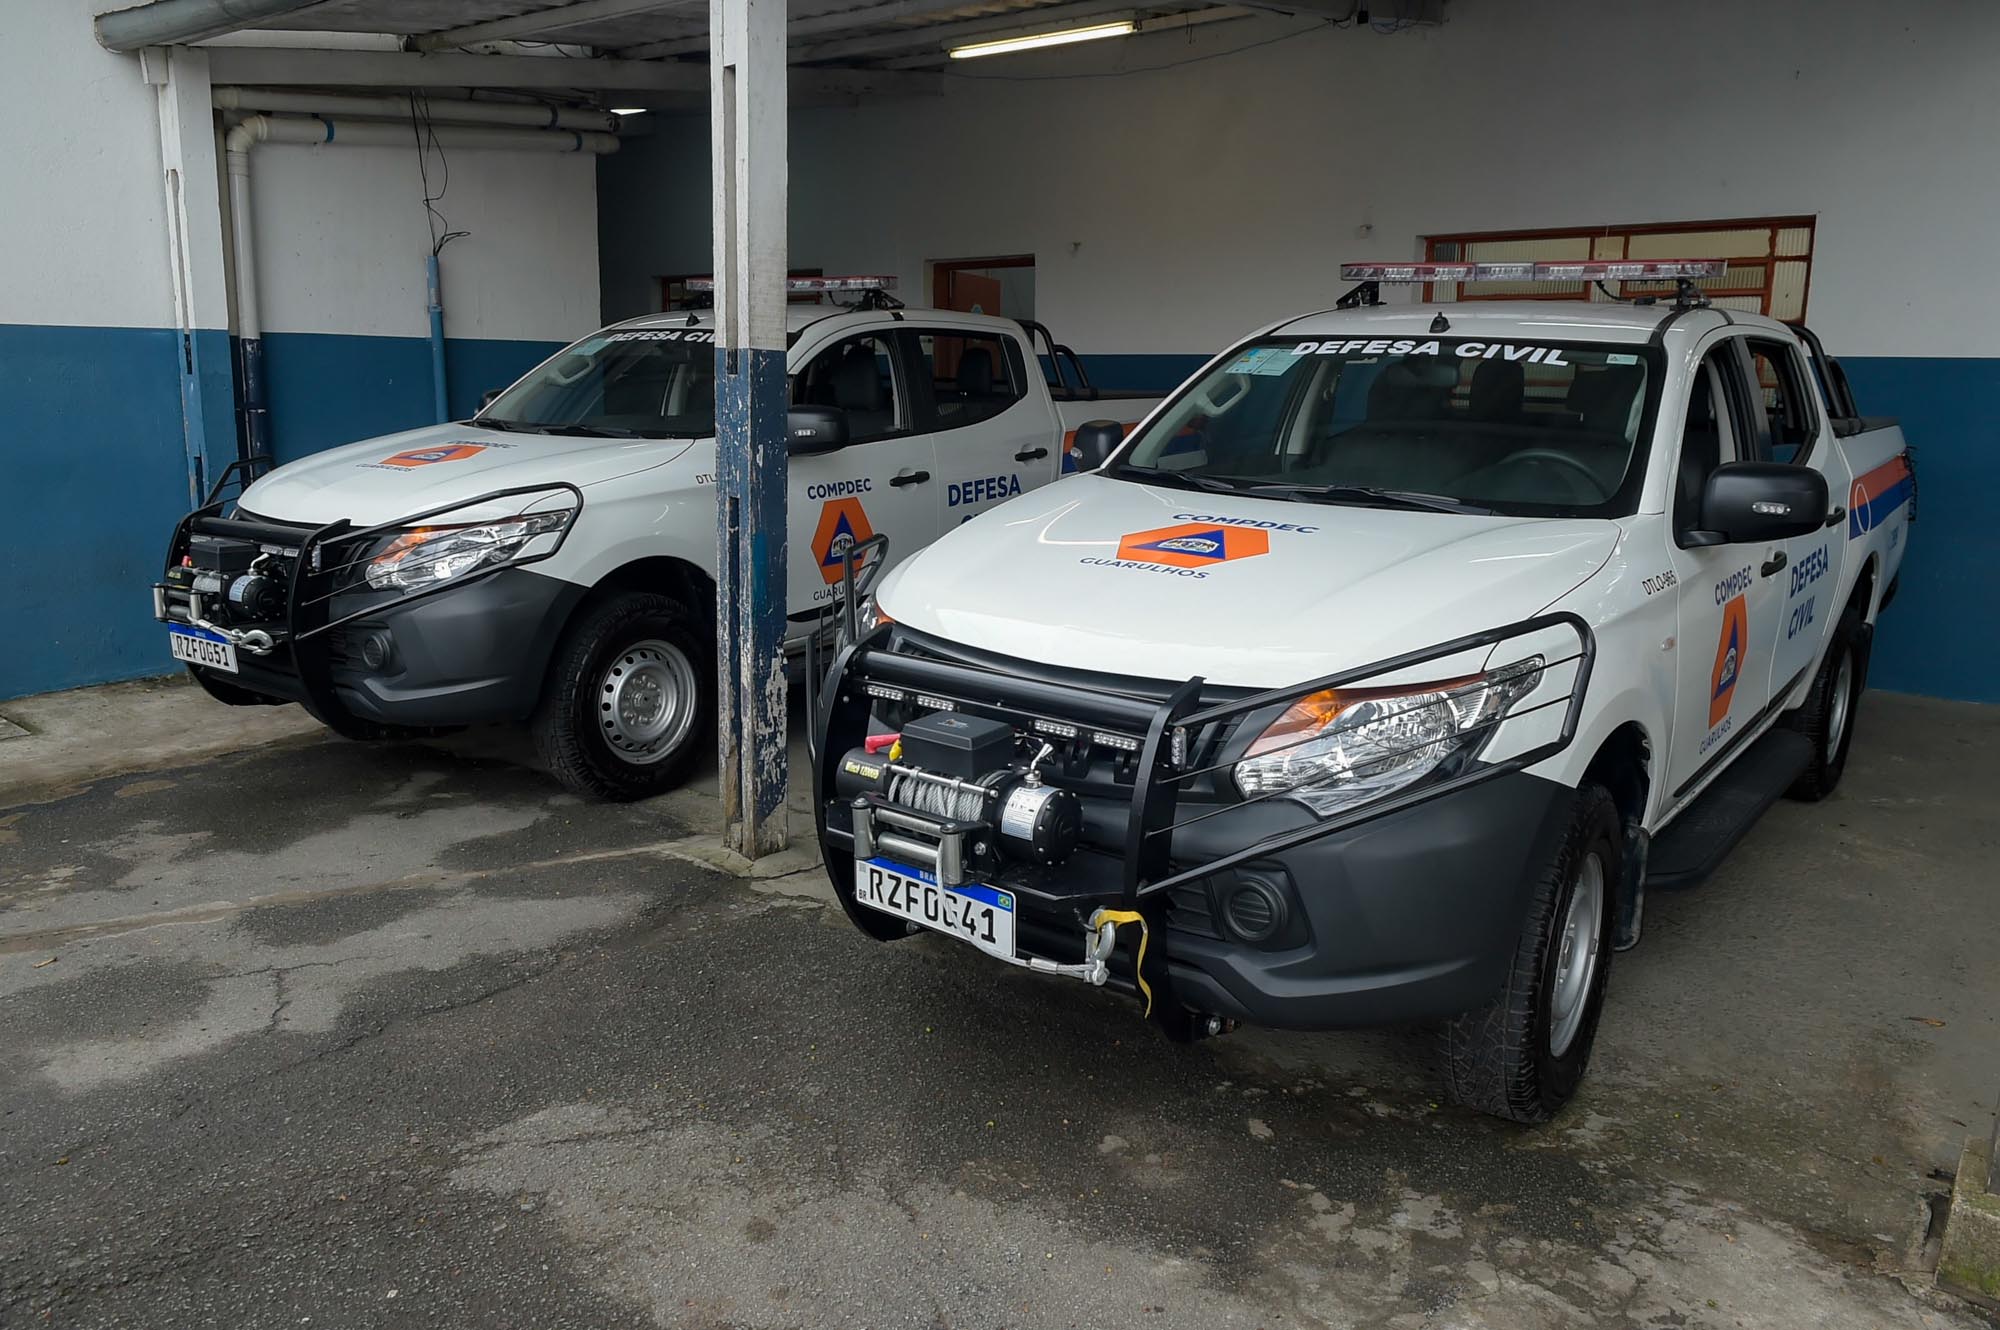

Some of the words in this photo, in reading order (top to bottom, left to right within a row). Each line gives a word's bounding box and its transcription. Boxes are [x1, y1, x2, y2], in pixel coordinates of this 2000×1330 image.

[605, 331, 682, 342] DEFESA
[1290, 340, 1440, 355] DEFESA
[1455, 342, 1569, 366] CIVIL
[696, 473, 717, 484] DTL
[807, 478, 872, 500] COMPDEC
[948, 473, 1022, 507] DEFESA
[1173, 513, 1320, 534] COMPDEC
[1080, 557, 1210, 579] GUARULHOS
[1790, 543, 1829, 599] DEFESA
[1715, 565, 1753, 605] COMPDEC
[1788, 595, 1815, 640] CIVIL
